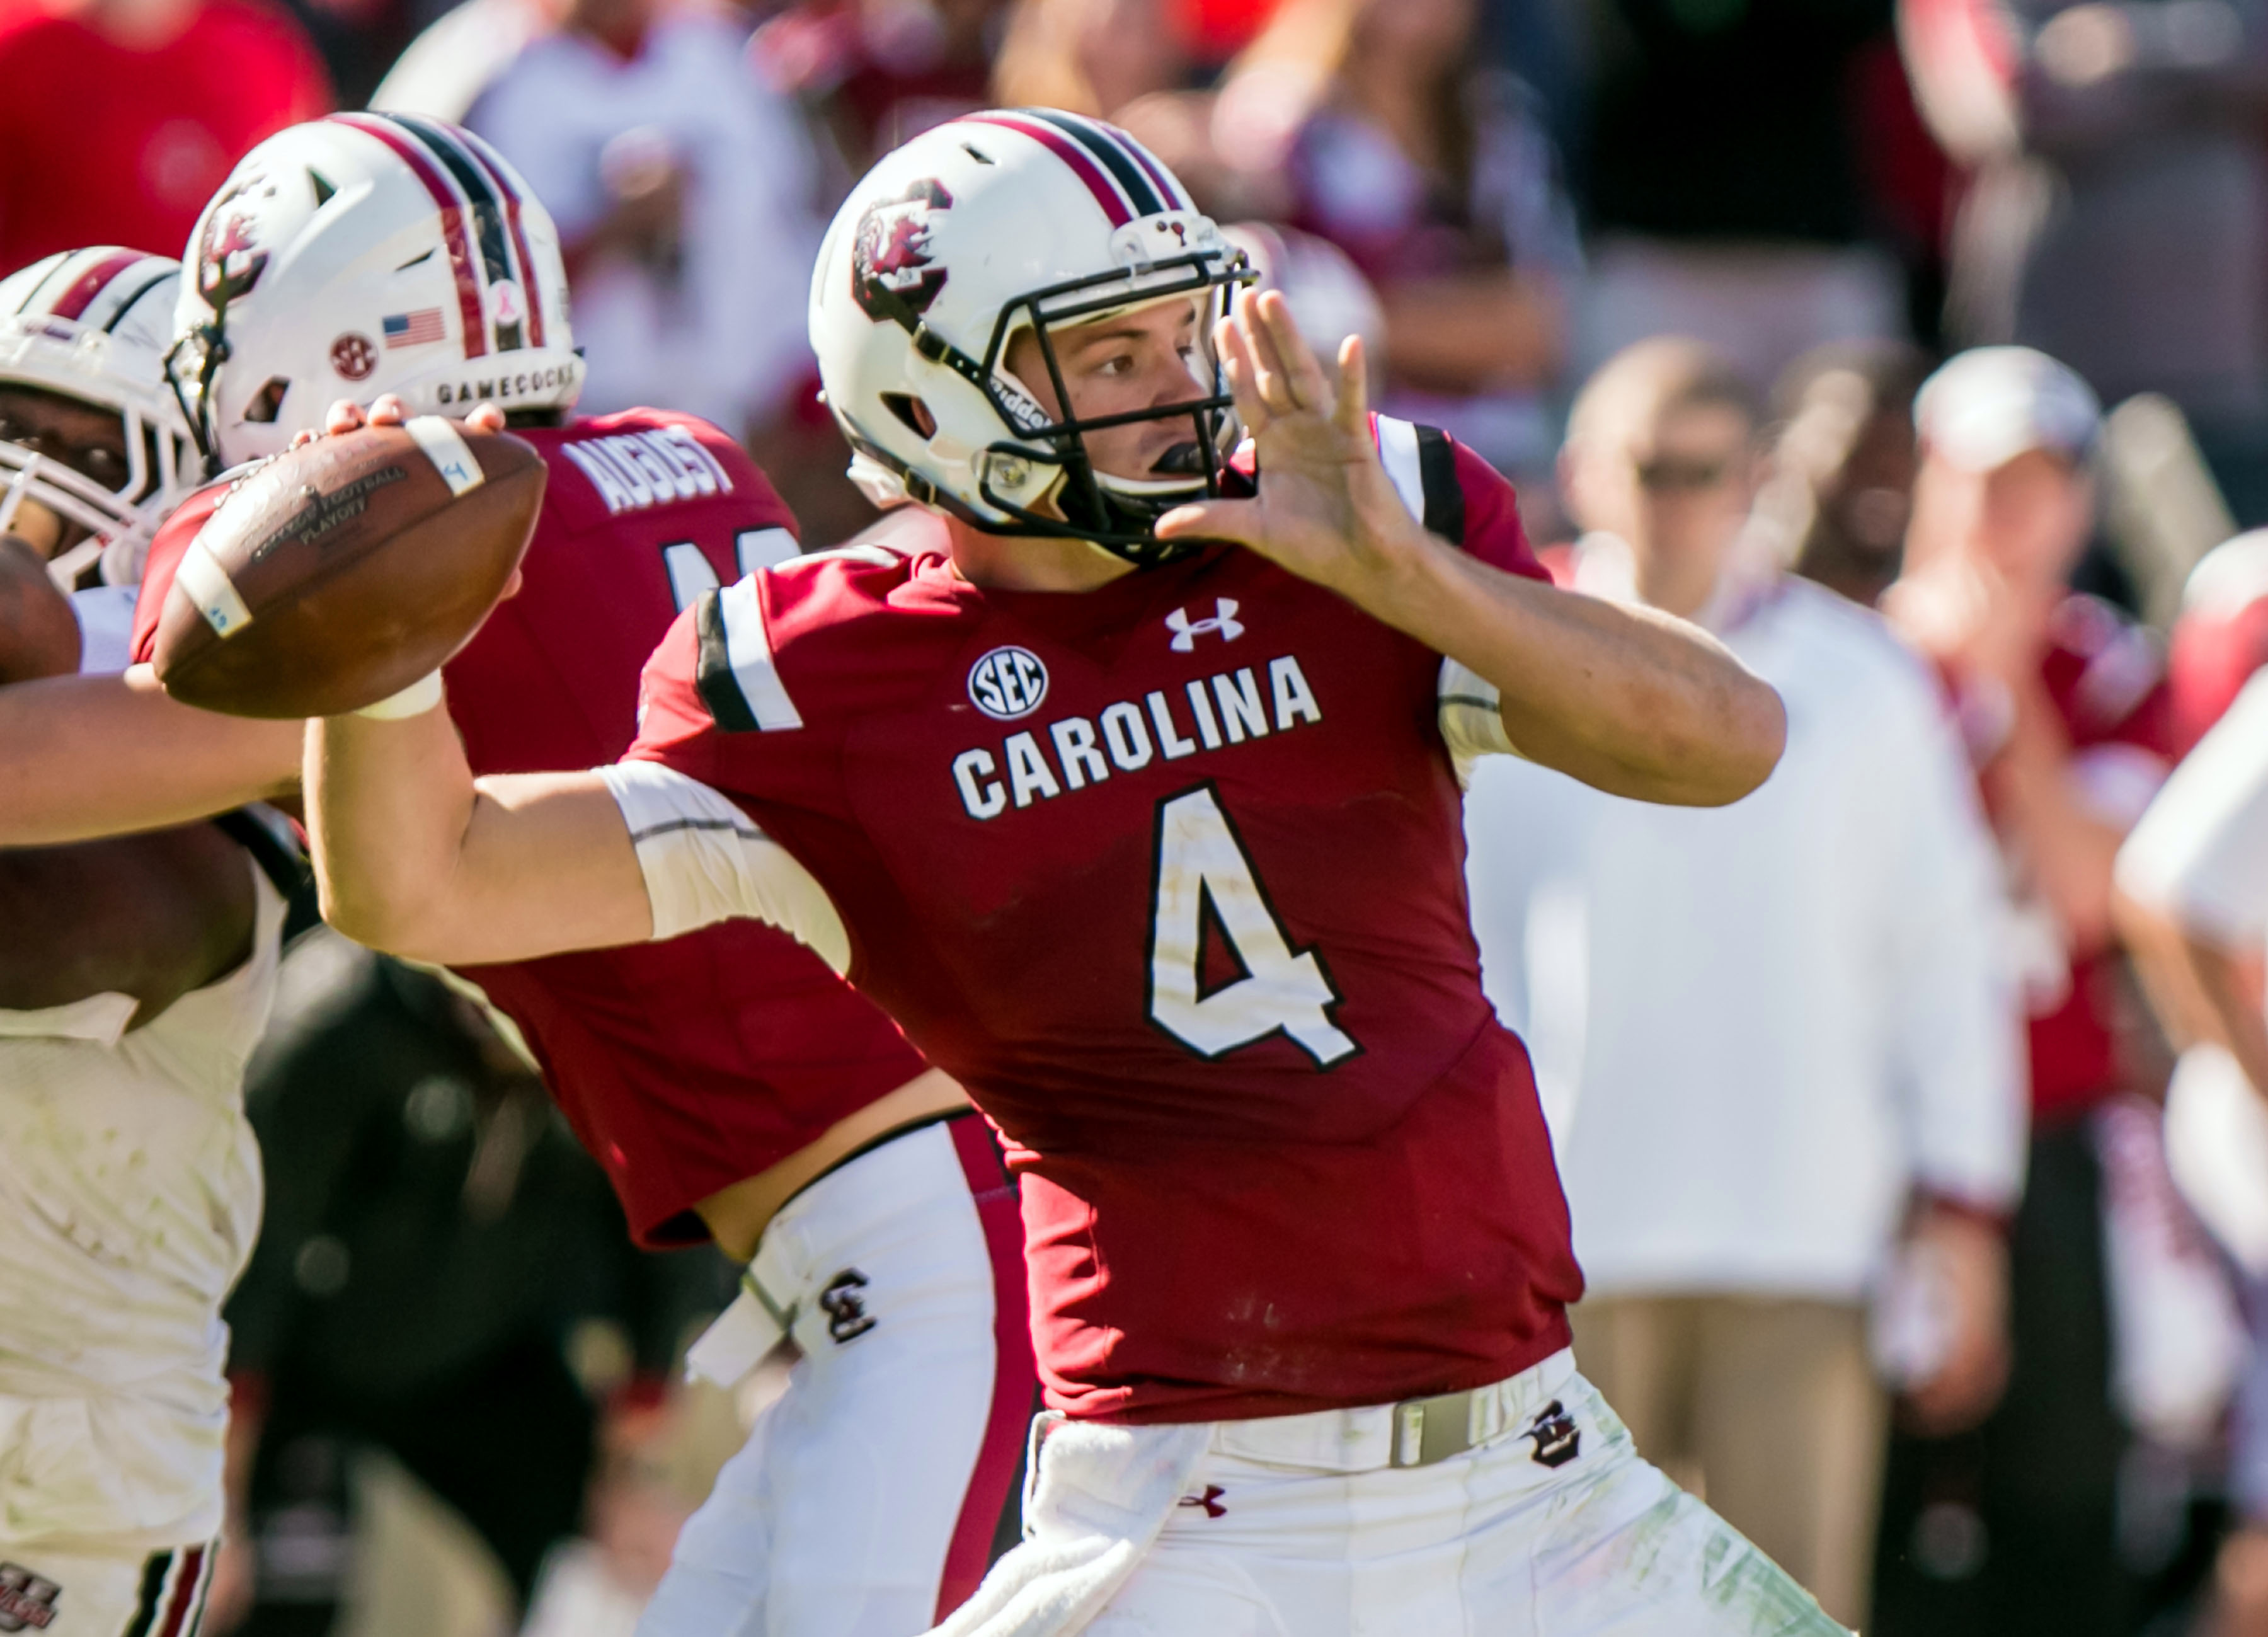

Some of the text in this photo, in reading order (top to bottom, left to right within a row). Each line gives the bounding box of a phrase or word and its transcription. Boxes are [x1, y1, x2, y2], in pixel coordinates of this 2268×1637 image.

[559, 423, 734, 515] AUGUST
[300, 495, 367, 546] PLAYOFF
[973, 649, 1043, 715] SEC
[951, 654, 1324, 822] CAROLINA
[1147, 780, 1364, 1070] 4
